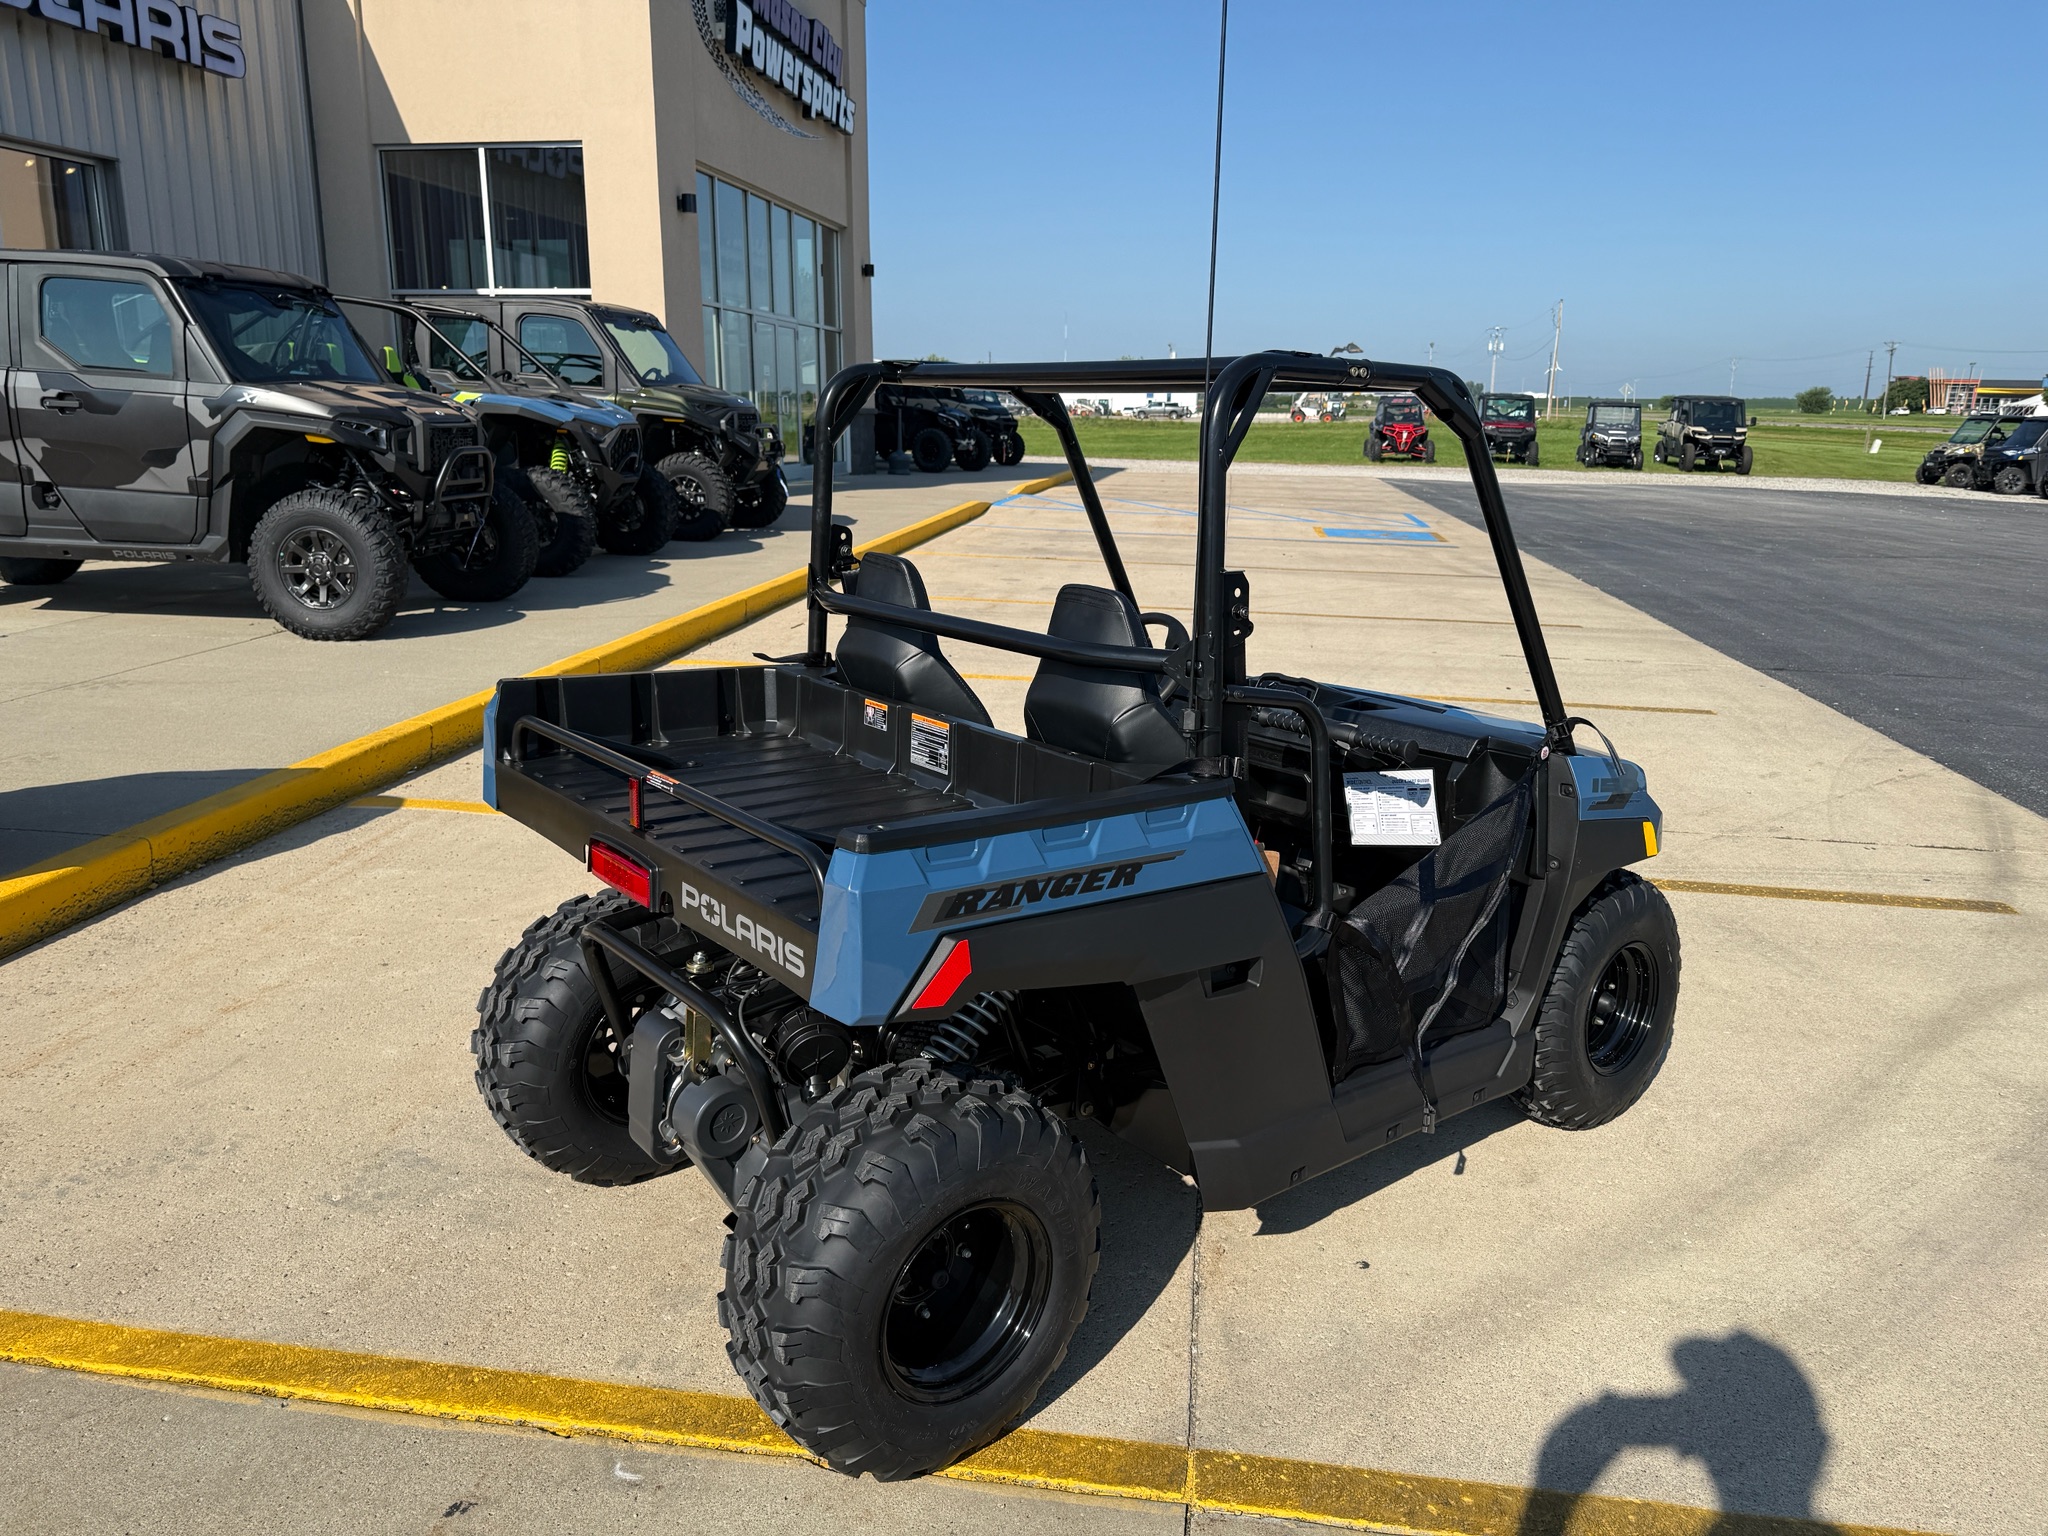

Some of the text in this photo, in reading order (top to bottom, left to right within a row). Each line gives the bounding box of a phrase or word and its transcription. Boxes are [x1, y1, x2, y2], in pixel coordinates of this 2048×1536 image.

[0, 0, 246, 79] ARIS
[735, 0, 856, 135] Powersports
[112, 549, 177, 560] POLARIS
[945, 862, 1143, 918] RANGER
[681, 881, 806, 979] POLARIS
